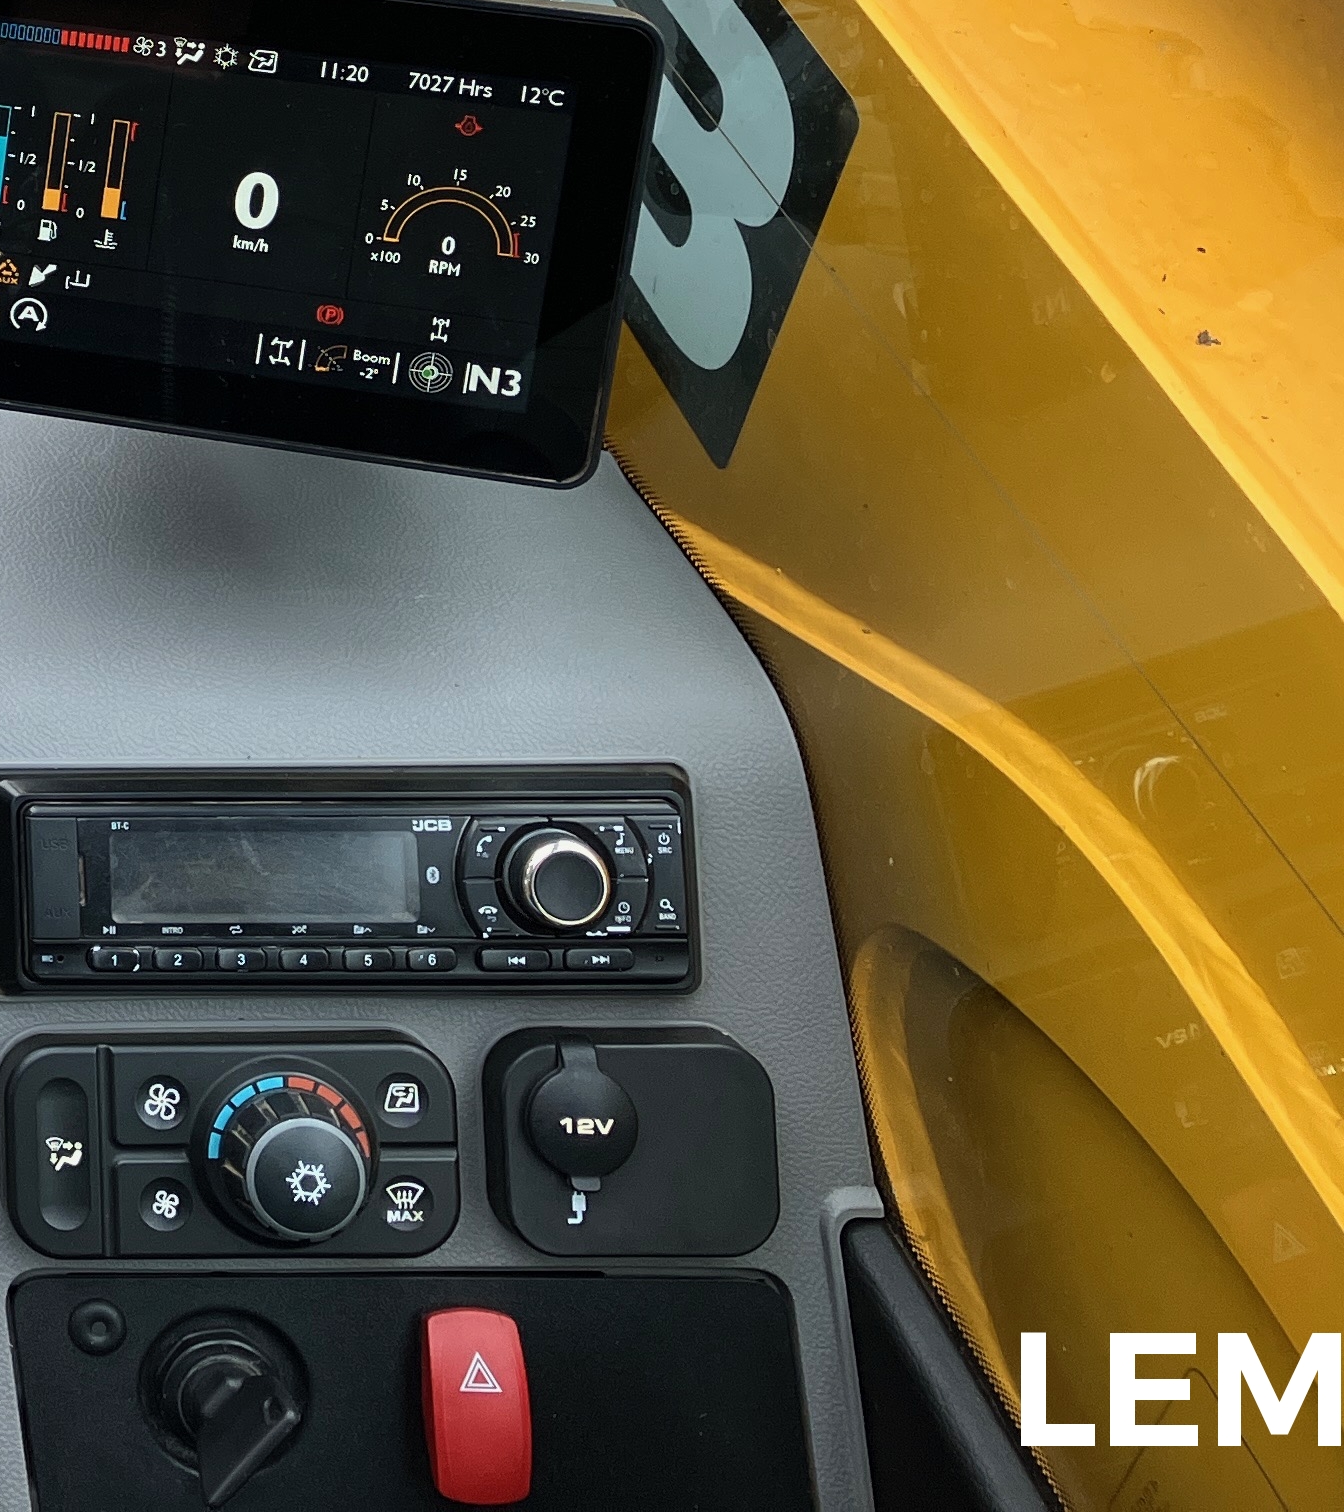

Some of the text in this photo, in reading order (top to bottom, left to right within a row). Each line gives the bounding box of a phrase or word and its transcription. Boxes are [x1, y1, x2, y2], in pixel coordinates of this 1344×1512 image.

[155, 40, 167, 58] 3
[320, 61, 369, 83] 11:20
[408, 71, 493, 98] 7027 Hrs
[520, 85, 565, 107] 12°C
[18, 151, 37, 165] 1/2
[78, 159, 96, 173] 1/2
[407, 173, 421, 186] 10
[453, 168, 468, 181] 15
[495, 185, 511, 198] 20
[17, 199, 26, 211] 0
[235, 172, 279, 229] 0
[379, 199, 389, 210] 5
[75, 207, 85, 218] 0
[520, 215, 537, 228] 25
[232, 234, 269, 253] km/h
[365, 232, 374, 245] 0
[441, 236, 456, 255] 0
[370, 250, 401, 264] x100
[523, 252, 540, 265] 30
[428, 259, 461, 277] RPM
[352, 349, 391, 366] Boom
[468, 363, 523, 397] N3
[411, 819, 453, 832] JCB
[111, 954, 118, 966] 1
[173, 954, 182, 966] 2
[237, 954, 246, 966] 3
[299, 954, 308, 966] 4
[364, 954, 373, 967] 5
[428, 954, 437, 966] 6
[559, 1117, 615, 1136] 12V
[386, 1209, 425, 1224] MAX
